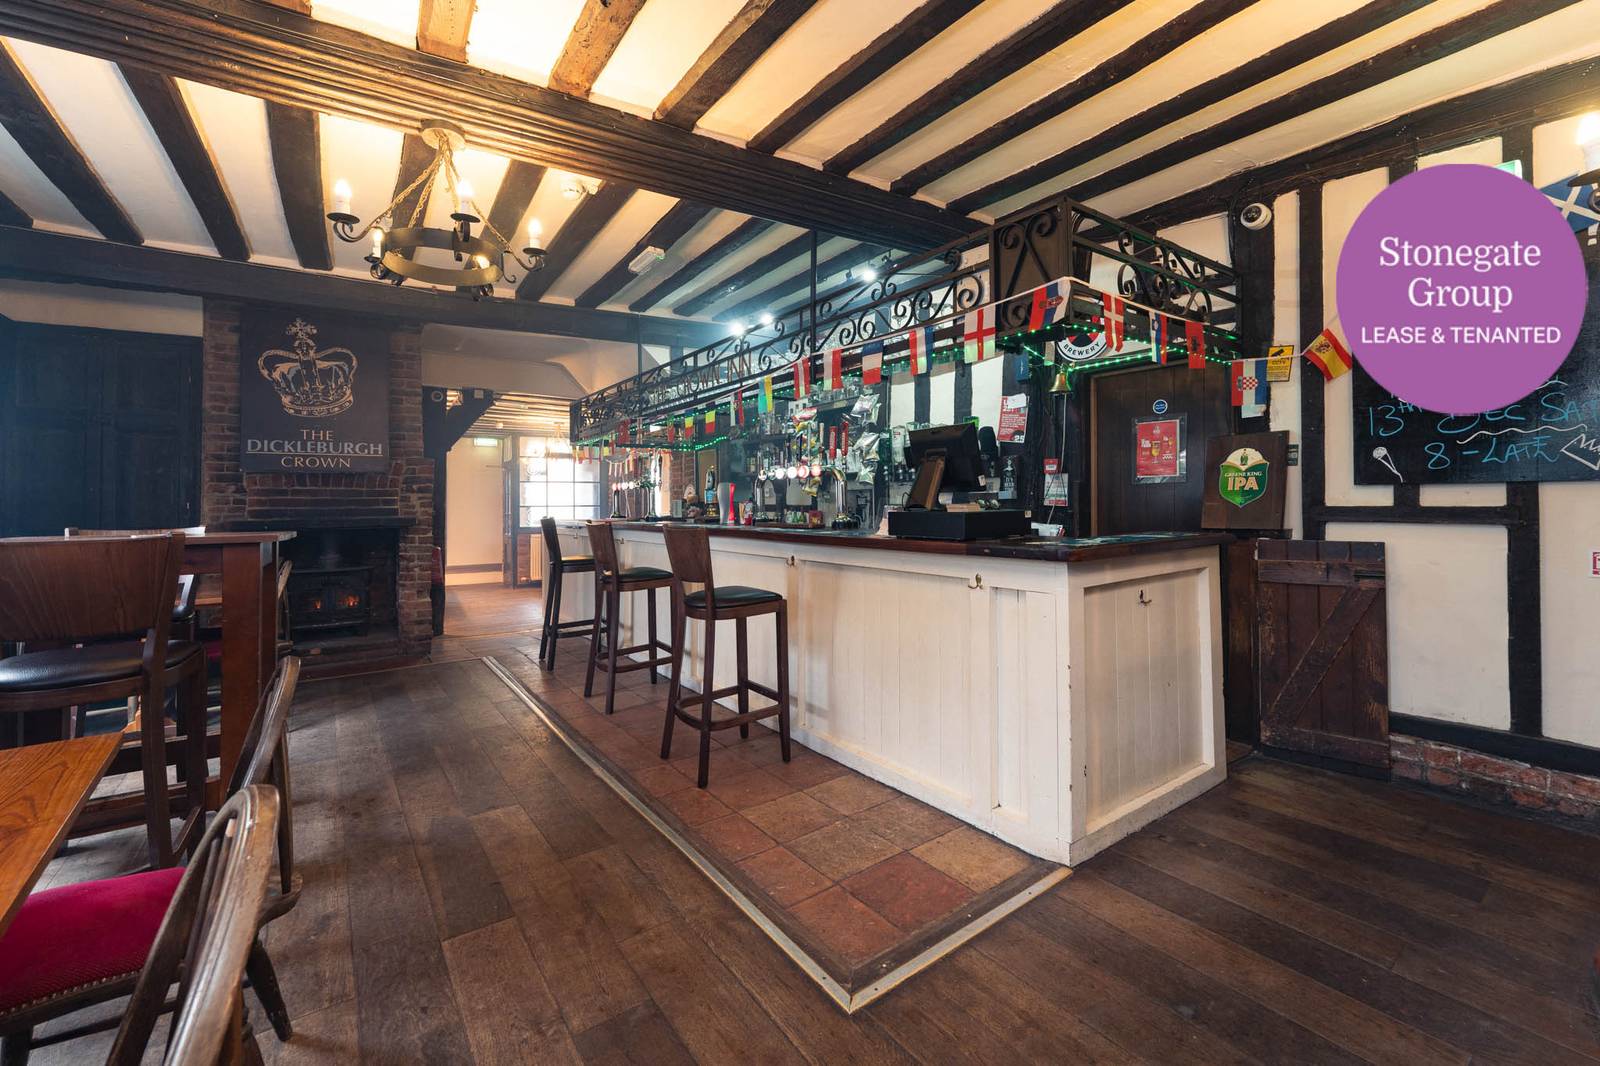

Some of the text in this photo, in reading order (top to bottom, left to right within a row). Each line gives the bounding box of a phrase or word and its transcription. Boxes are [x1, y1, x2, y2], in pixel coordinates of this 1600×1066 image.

[1063, 342, 1101, 356] BREWERY
[677, 364, 721, 397] CROWN
[727, 351, 752, 383] INN
[300, 429, 334, 441] THE
[246, 439, 383, 454] DICKLEBURGH
[280, 456, 351, 468] CROWN
[1227, 476, 1259, 491] IPA
